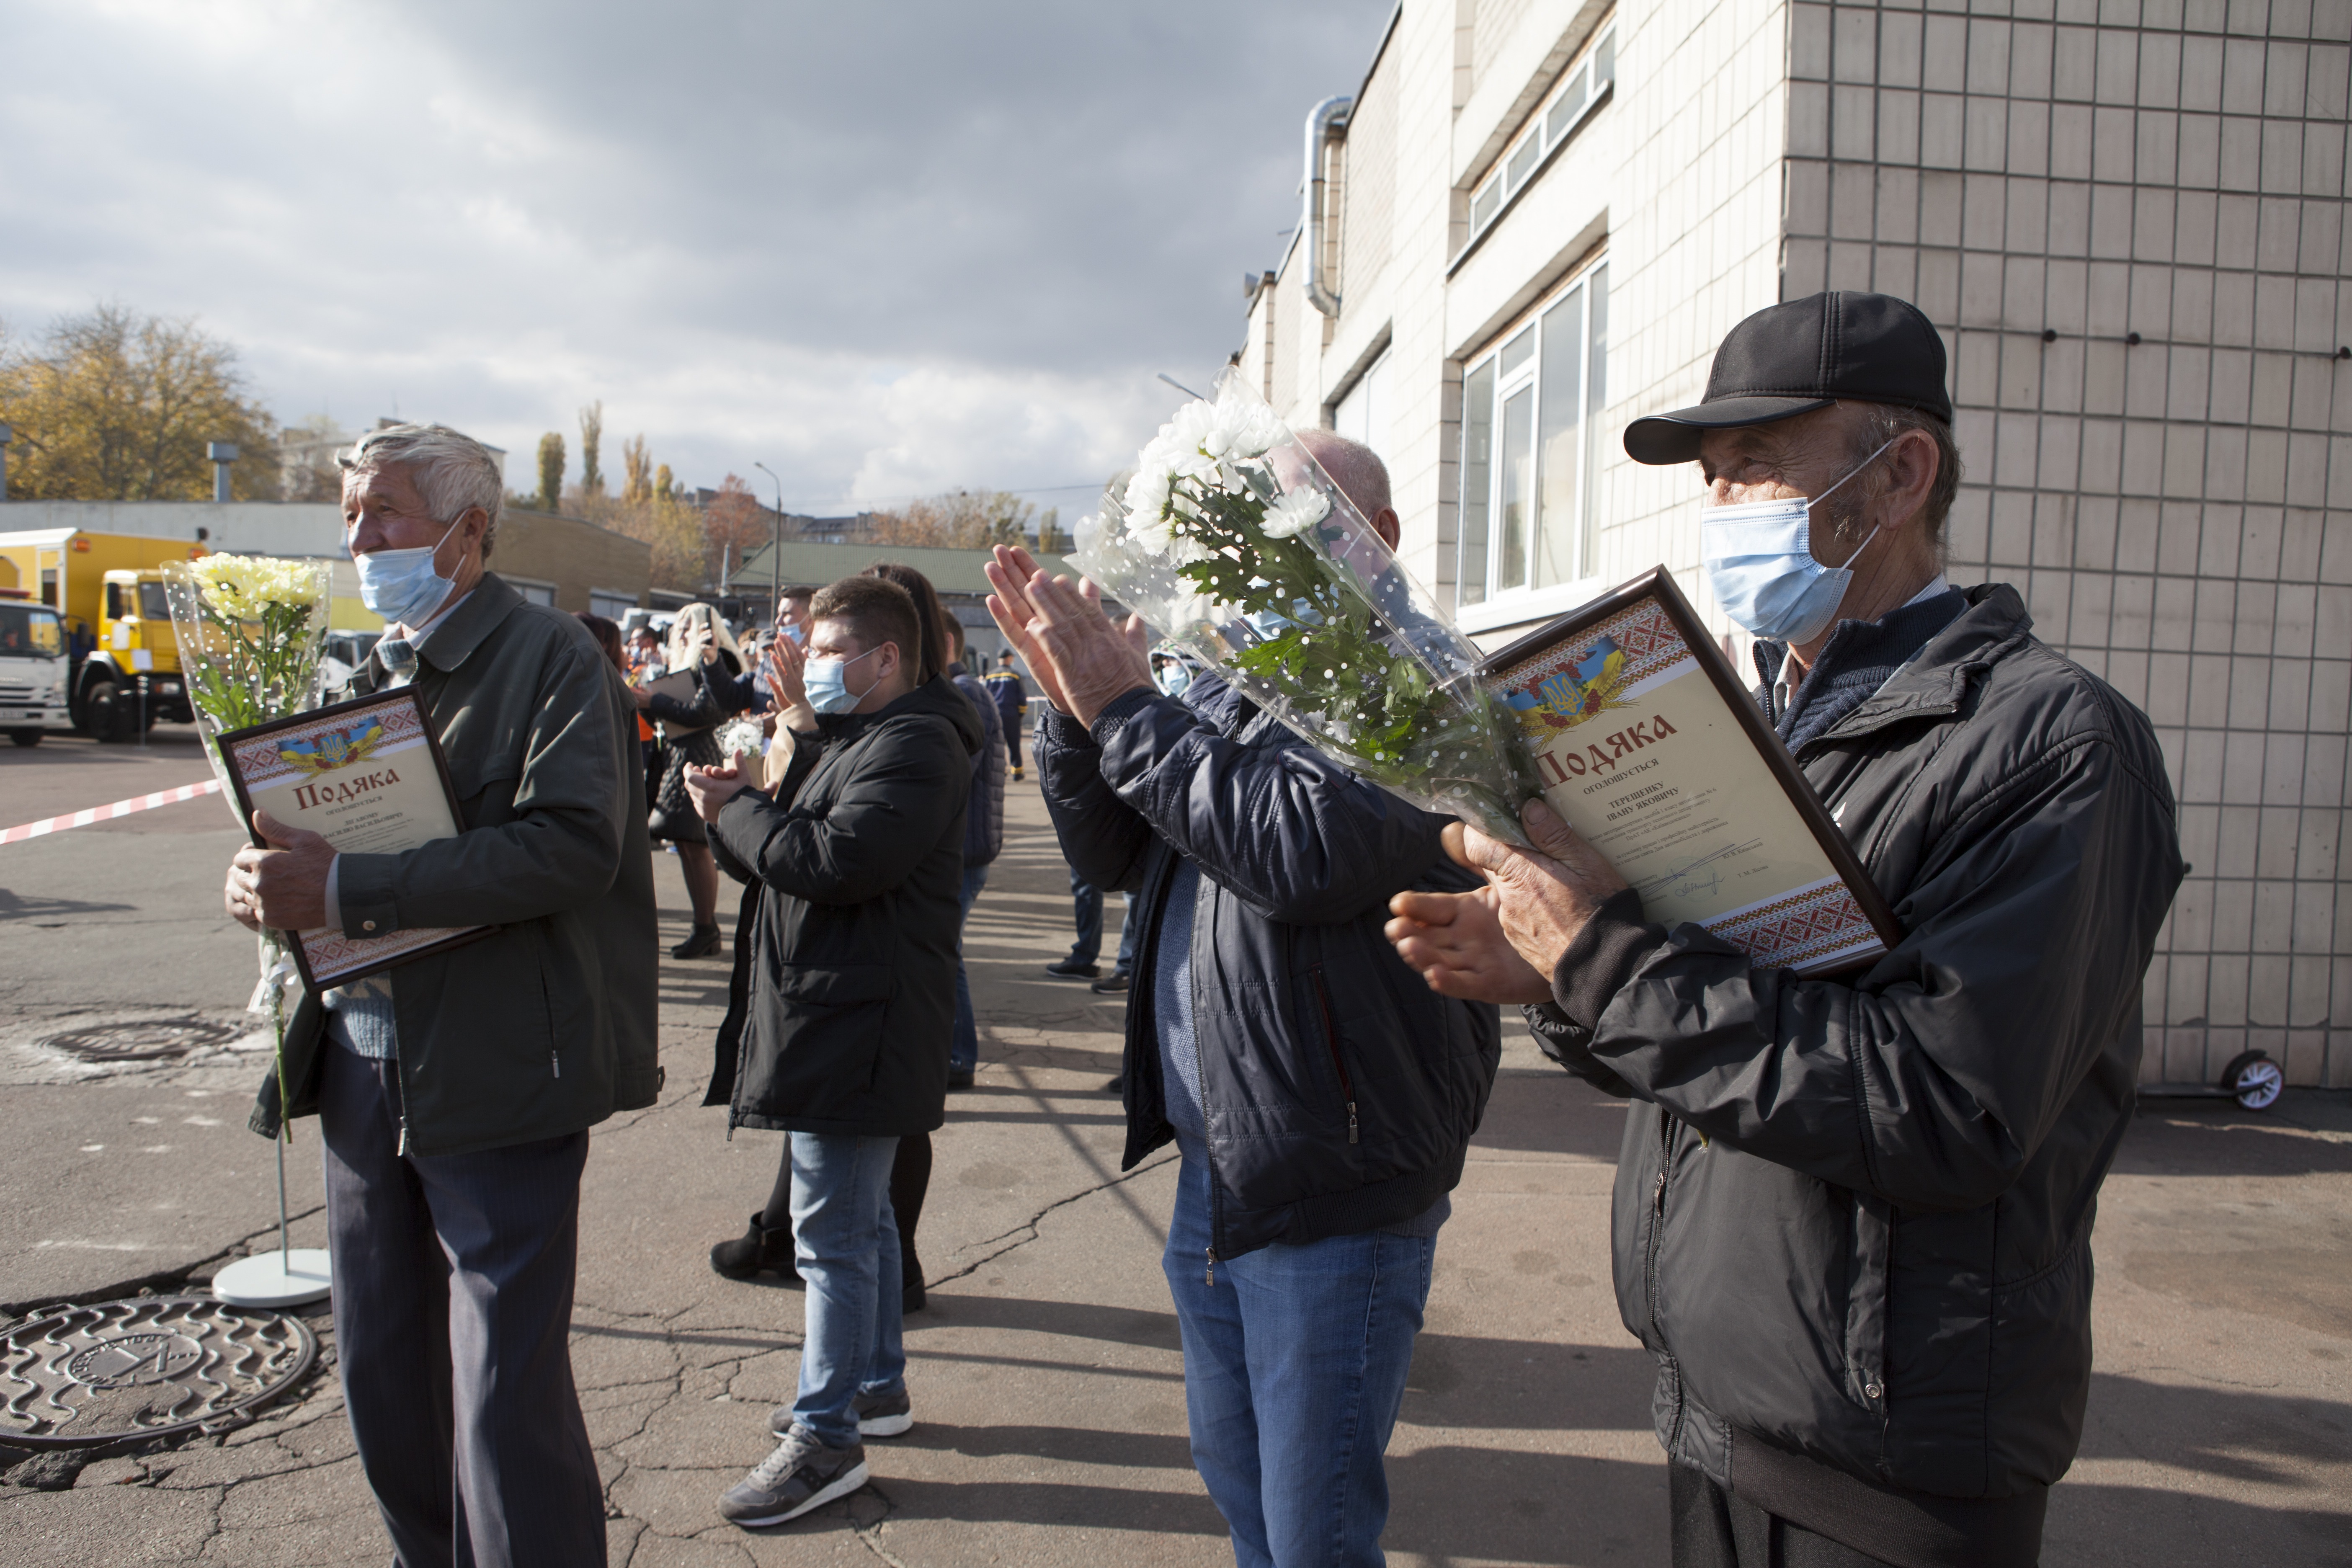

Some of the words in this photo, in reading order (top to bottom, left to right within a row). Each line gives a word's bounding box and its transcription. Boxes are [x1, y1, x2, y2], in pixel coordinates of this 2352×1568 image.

[1583, 758, 1659, 794] ОГОЛОШУЄТЬСЯ
[1606, 805, 1634, 821] ІВАНУ
[1635, 787, 1679, 810] ЯКОВИЧУ
[1608, 781, 1664, 809] ТЕРЕЩЕНКУ
